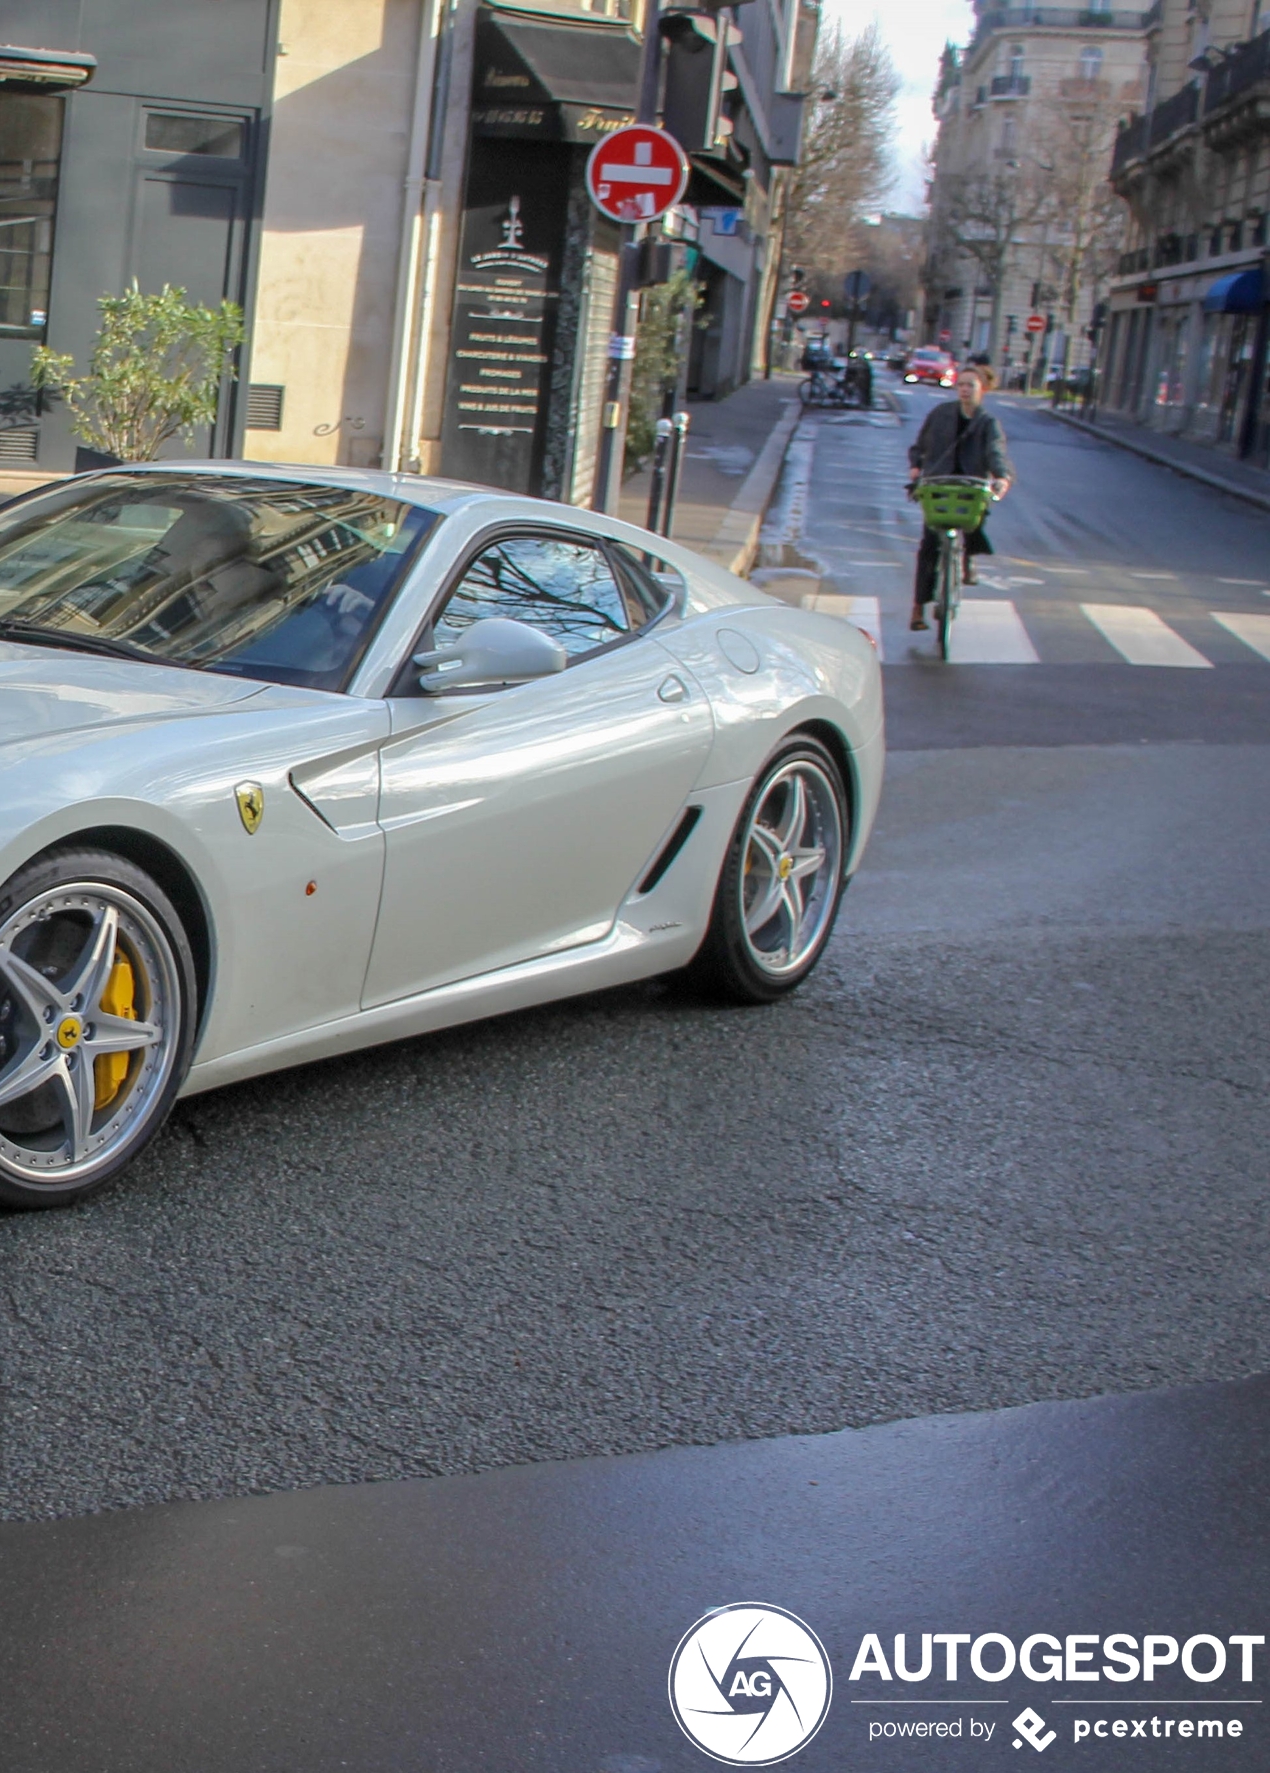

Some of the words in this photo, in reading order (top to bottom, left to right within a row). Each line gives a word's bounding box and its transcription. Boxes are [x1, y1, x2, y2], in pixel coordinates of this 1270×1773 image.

[468, 333, 496, 342] FRUITS
[455, 349, 508, 361] CHARCUTERIE
[515, 353, 548, 363] VIANDES
[479, 368, 522, 378] FROMAGES
[459, 384, 498, 395] PRODUITS
[499, 387, 509, 395] DE
[510, 388, 520, 396] LA
[458, 402, 477, 411] VINS
[484, 403, 498, 412] JUS
[499, 404, 509, 412] DE
[511, 405, 538, 414] FRUITS
